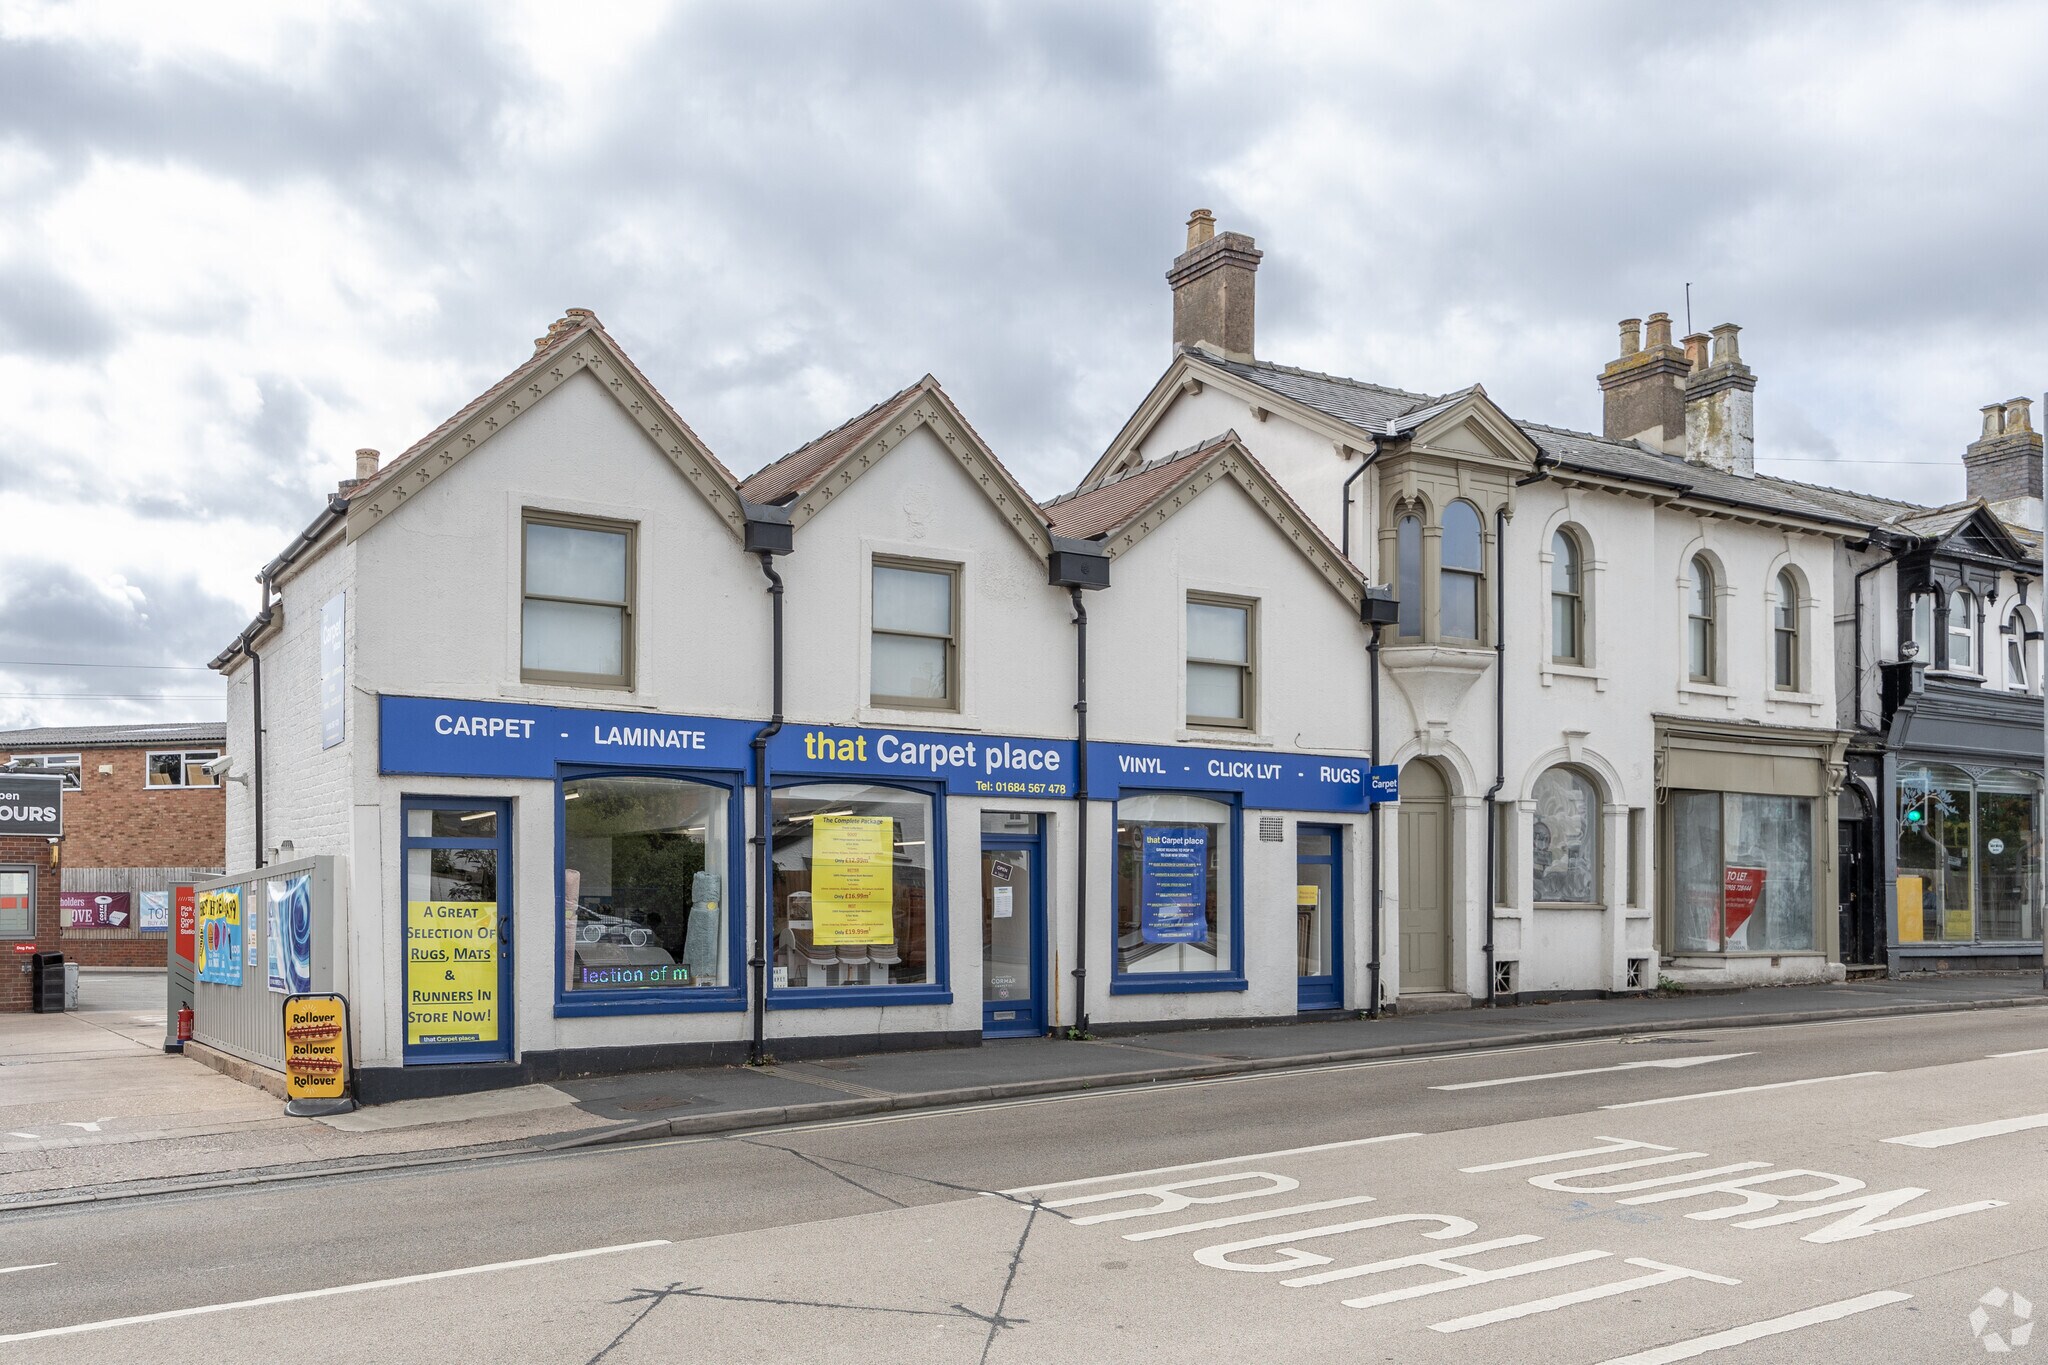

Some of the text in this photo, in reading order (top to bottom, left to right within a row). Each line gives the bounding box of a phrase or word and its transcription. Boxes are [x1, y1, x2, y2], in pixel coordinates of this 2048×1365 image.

[434, 714, 536, 739] CARPET
[594, 725, 706, 750] LAMINATE
[804, 731, 1060, 775] that Carpet place
[1118, 755, 1167, 774] VINYL
[1207, 759, 1254, 779] CLICK
[1257, 762, 1282, 780] LVT
[1320, 766, 1361, 784] RUGS
[976, 780, 1067, 795] Tel: 01684 567 478
[1371, 779, 1397, 790] Carpet
[0, 805, 57, 822] OURS
[834, 817, 860, 826] Complete
[861, 818, 884, 826] Package
[1146, 836, 1204, 846] that Carpet place
[1727, 871, 1748, 881] TO LET
[60, 896, 85, 907] holders
[180, 910, 189, 918] Up
[423, 906, 433, 917] A
[180, 917, 194, 925] Drop
[444, 970, 456, 981] &
[583, 966, 688, 983] lection of m
[293, 1012, 336, 1024] Rollover
[293, 1043, 336, 1055] Rollover
[294, 1074, 337, 1088] Rollover
[1457, 1135, 2010, 1245] TURN
[1022, 1171, 1743, 1333] RIGHT
